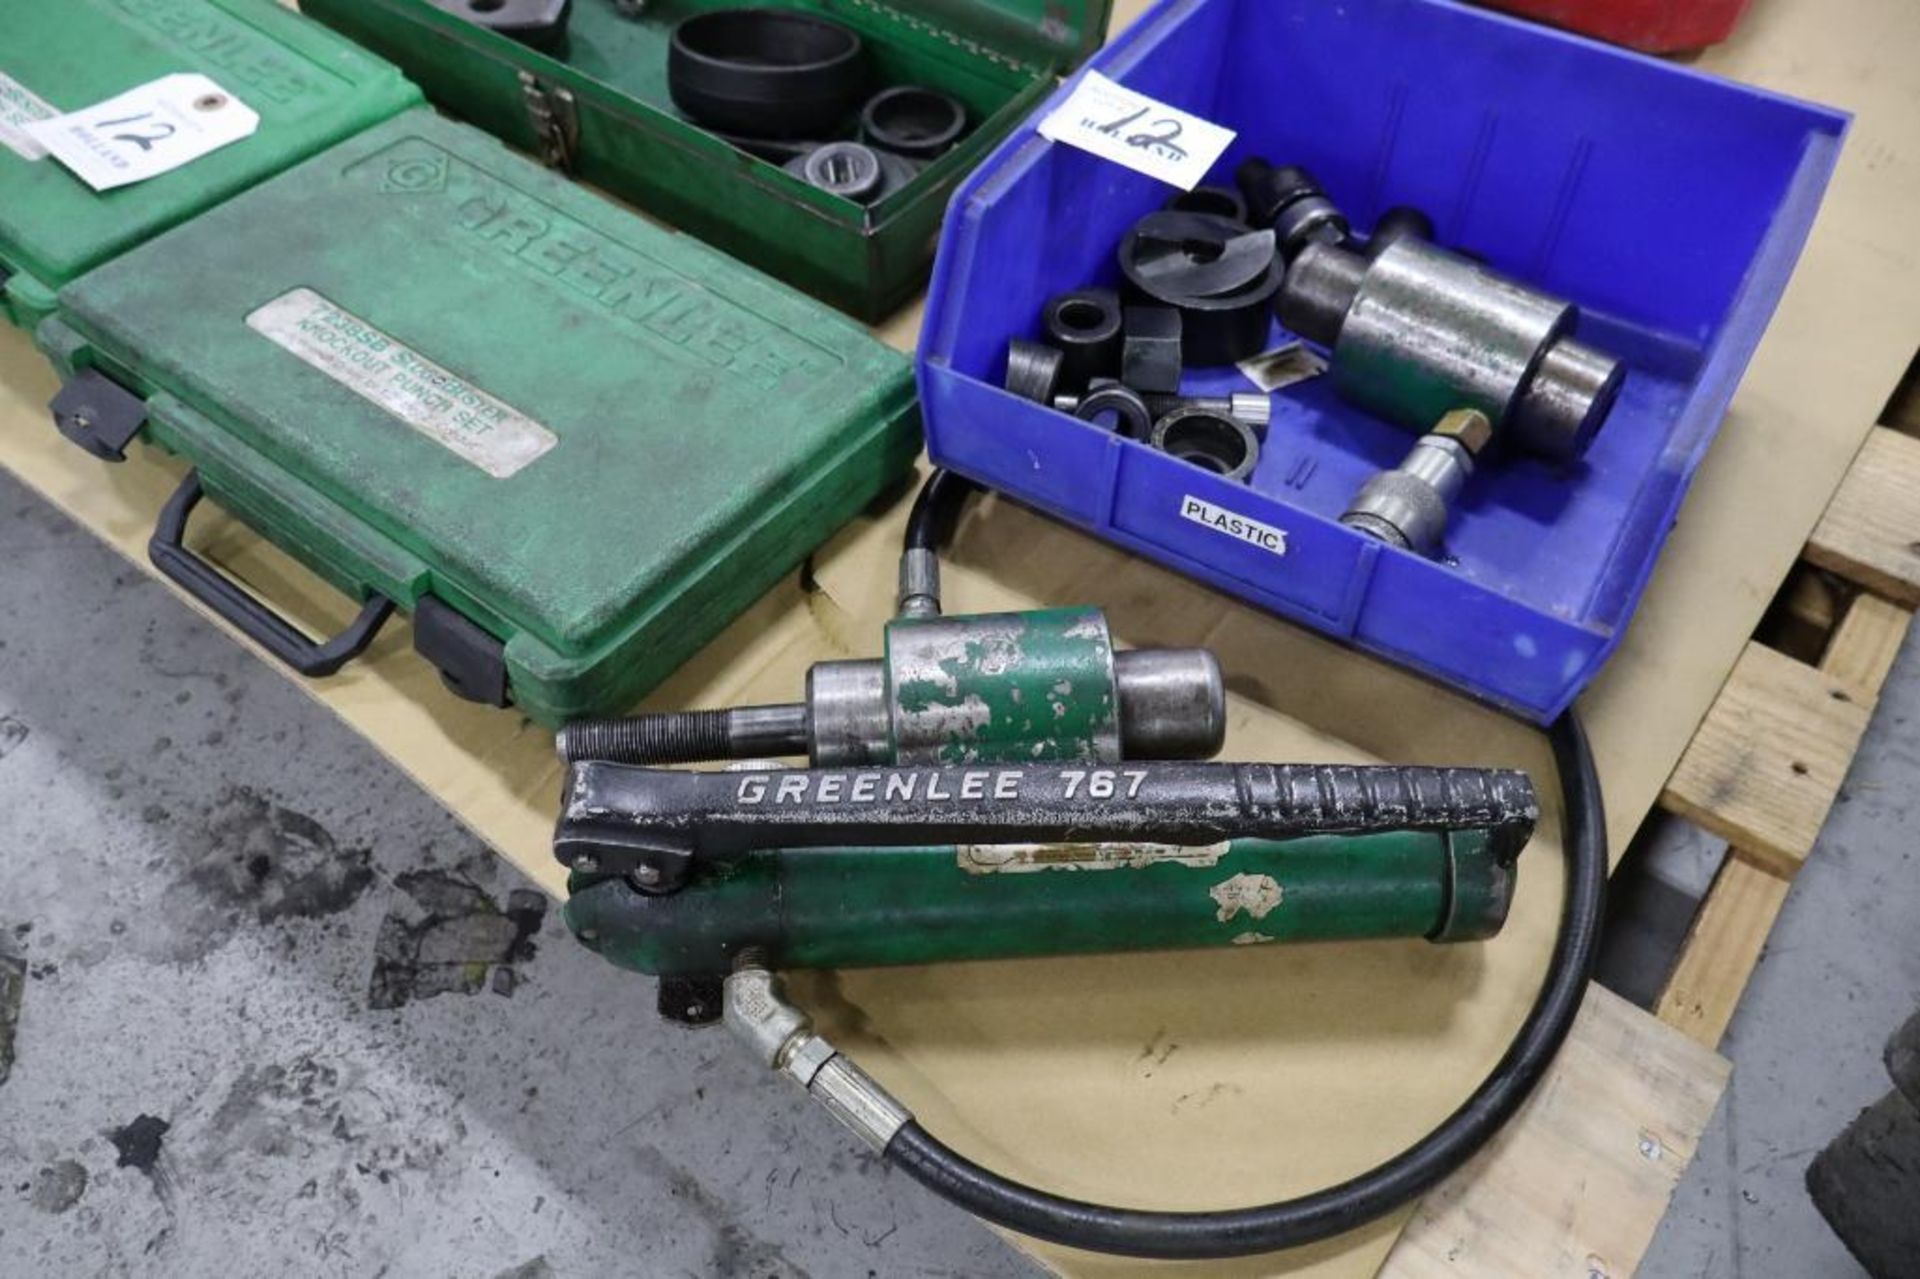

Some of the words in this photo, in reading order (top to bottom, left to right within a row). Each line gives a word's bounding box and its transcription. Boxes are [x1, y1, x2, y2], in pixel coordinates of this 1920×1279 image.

[94, 110, 177, 152] 12
[1098, 105, 1189, 157] 12
[297, 319, 391, 375] KNOCKOUT
[391, 371, 454, 412] PUNCH
[453, 409, 496, 436] SET
[1187, 501, 1278, 549] PLASTIC
[737, 771, 1025, 804] GREENLEE
[1059, 770, 1148, 799] 767
